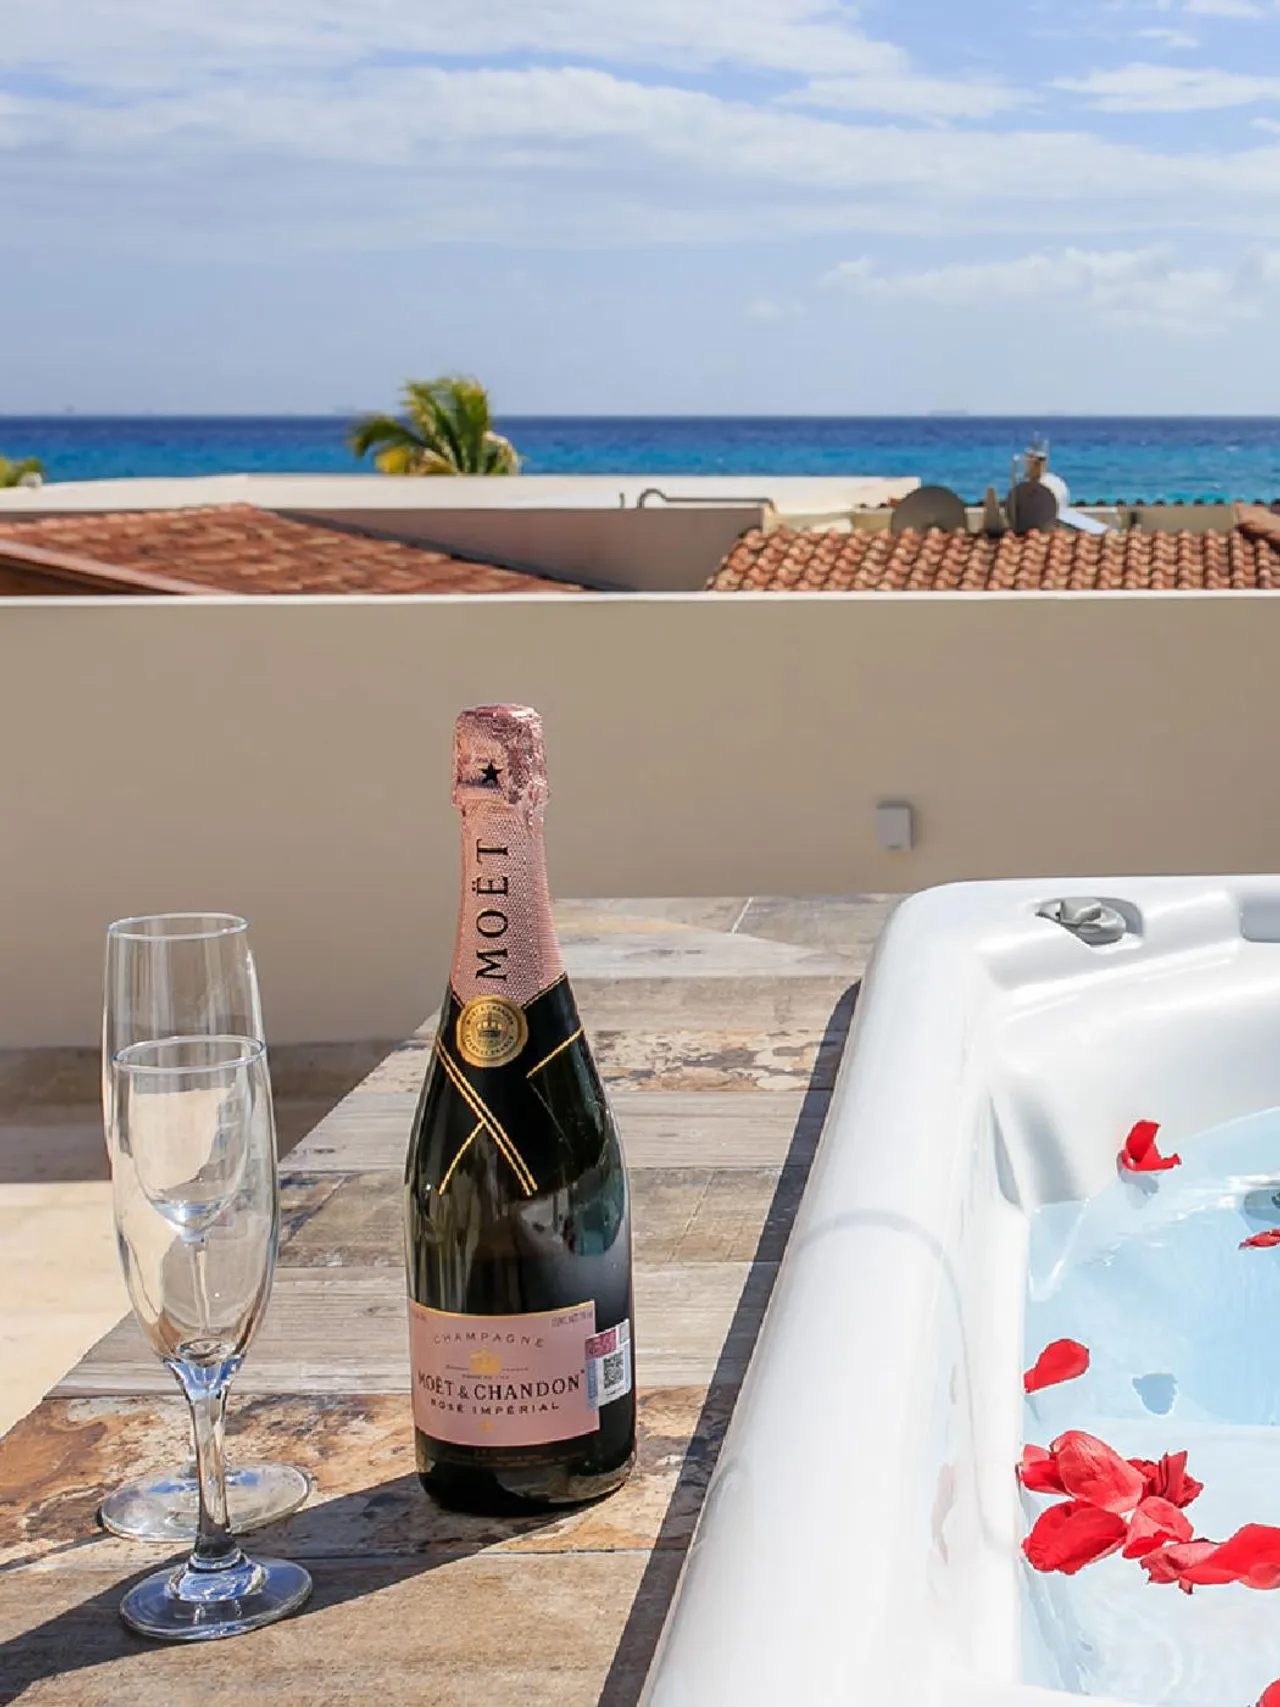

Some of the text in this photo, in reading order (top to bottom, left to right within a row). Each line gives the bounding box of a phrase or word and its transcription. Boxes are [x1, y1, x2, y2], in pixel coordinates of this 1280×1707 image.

[471, 838, 509, 981] MOËT
[433, 1331, 545, 1349] CHAMPAGNE
[458, 1384, 471, 1401] &
[474, 1373, 580, 1401] CHANDON
